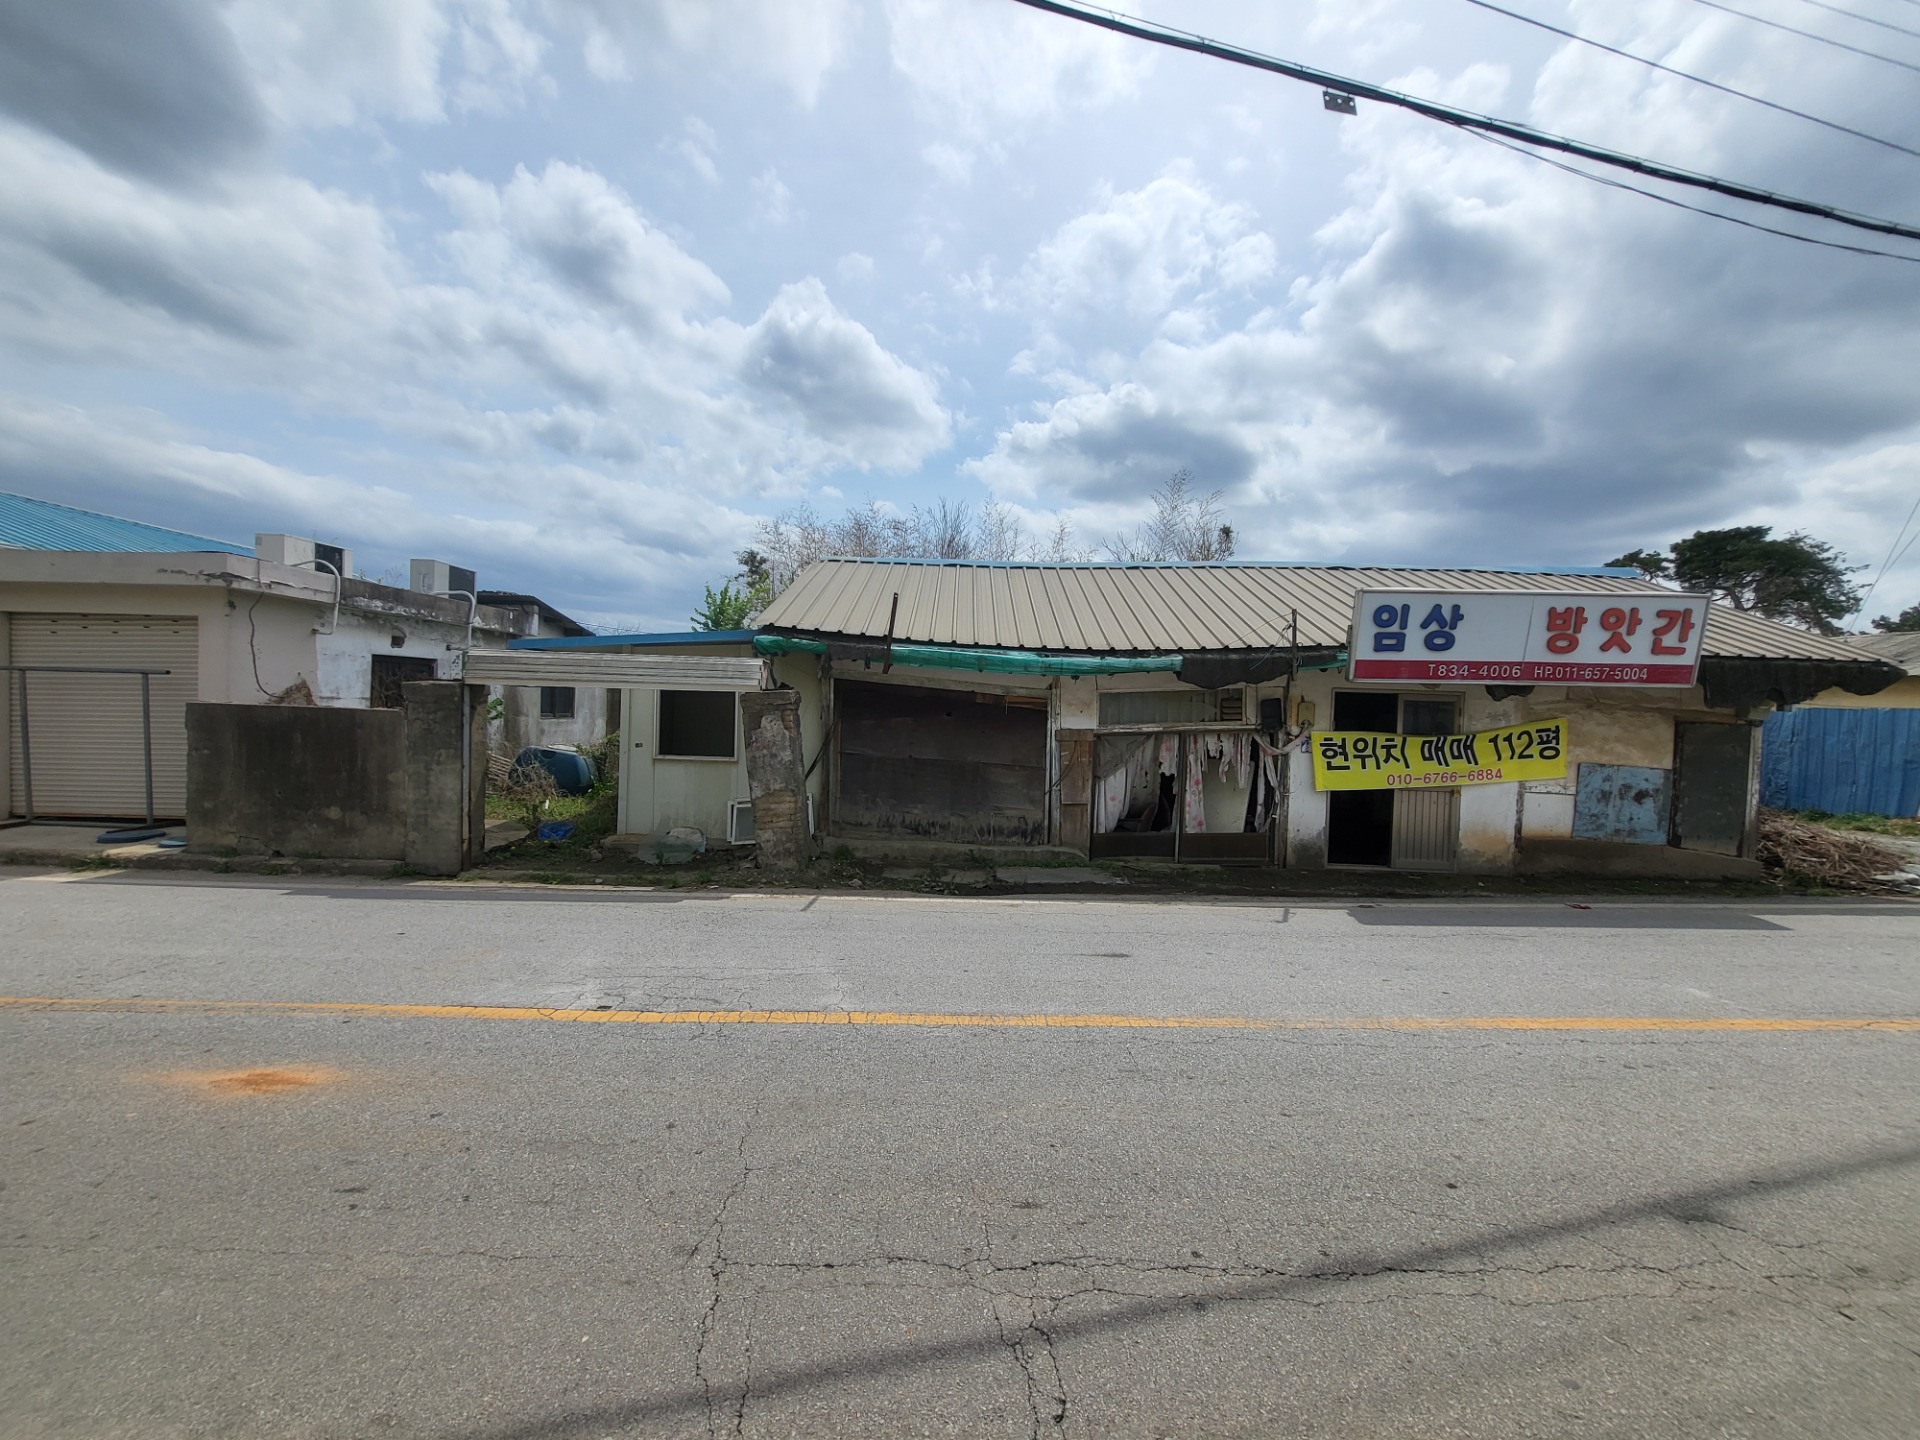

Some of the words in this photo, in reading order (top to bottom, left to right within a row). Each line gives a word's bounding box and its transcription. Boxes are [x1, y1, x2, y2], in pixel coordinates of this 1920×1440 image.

[1372, 603, 1464, 652] 임상
[1546, 605, 1695, 656] 방앗간
[1319, 735, 1410, 771] 현위치
[1420, 734, 1479, 766] 매매
[1488, 724, 1561, 761] 112평
[1387, 768, 1503, 786] 010-6766-6884
